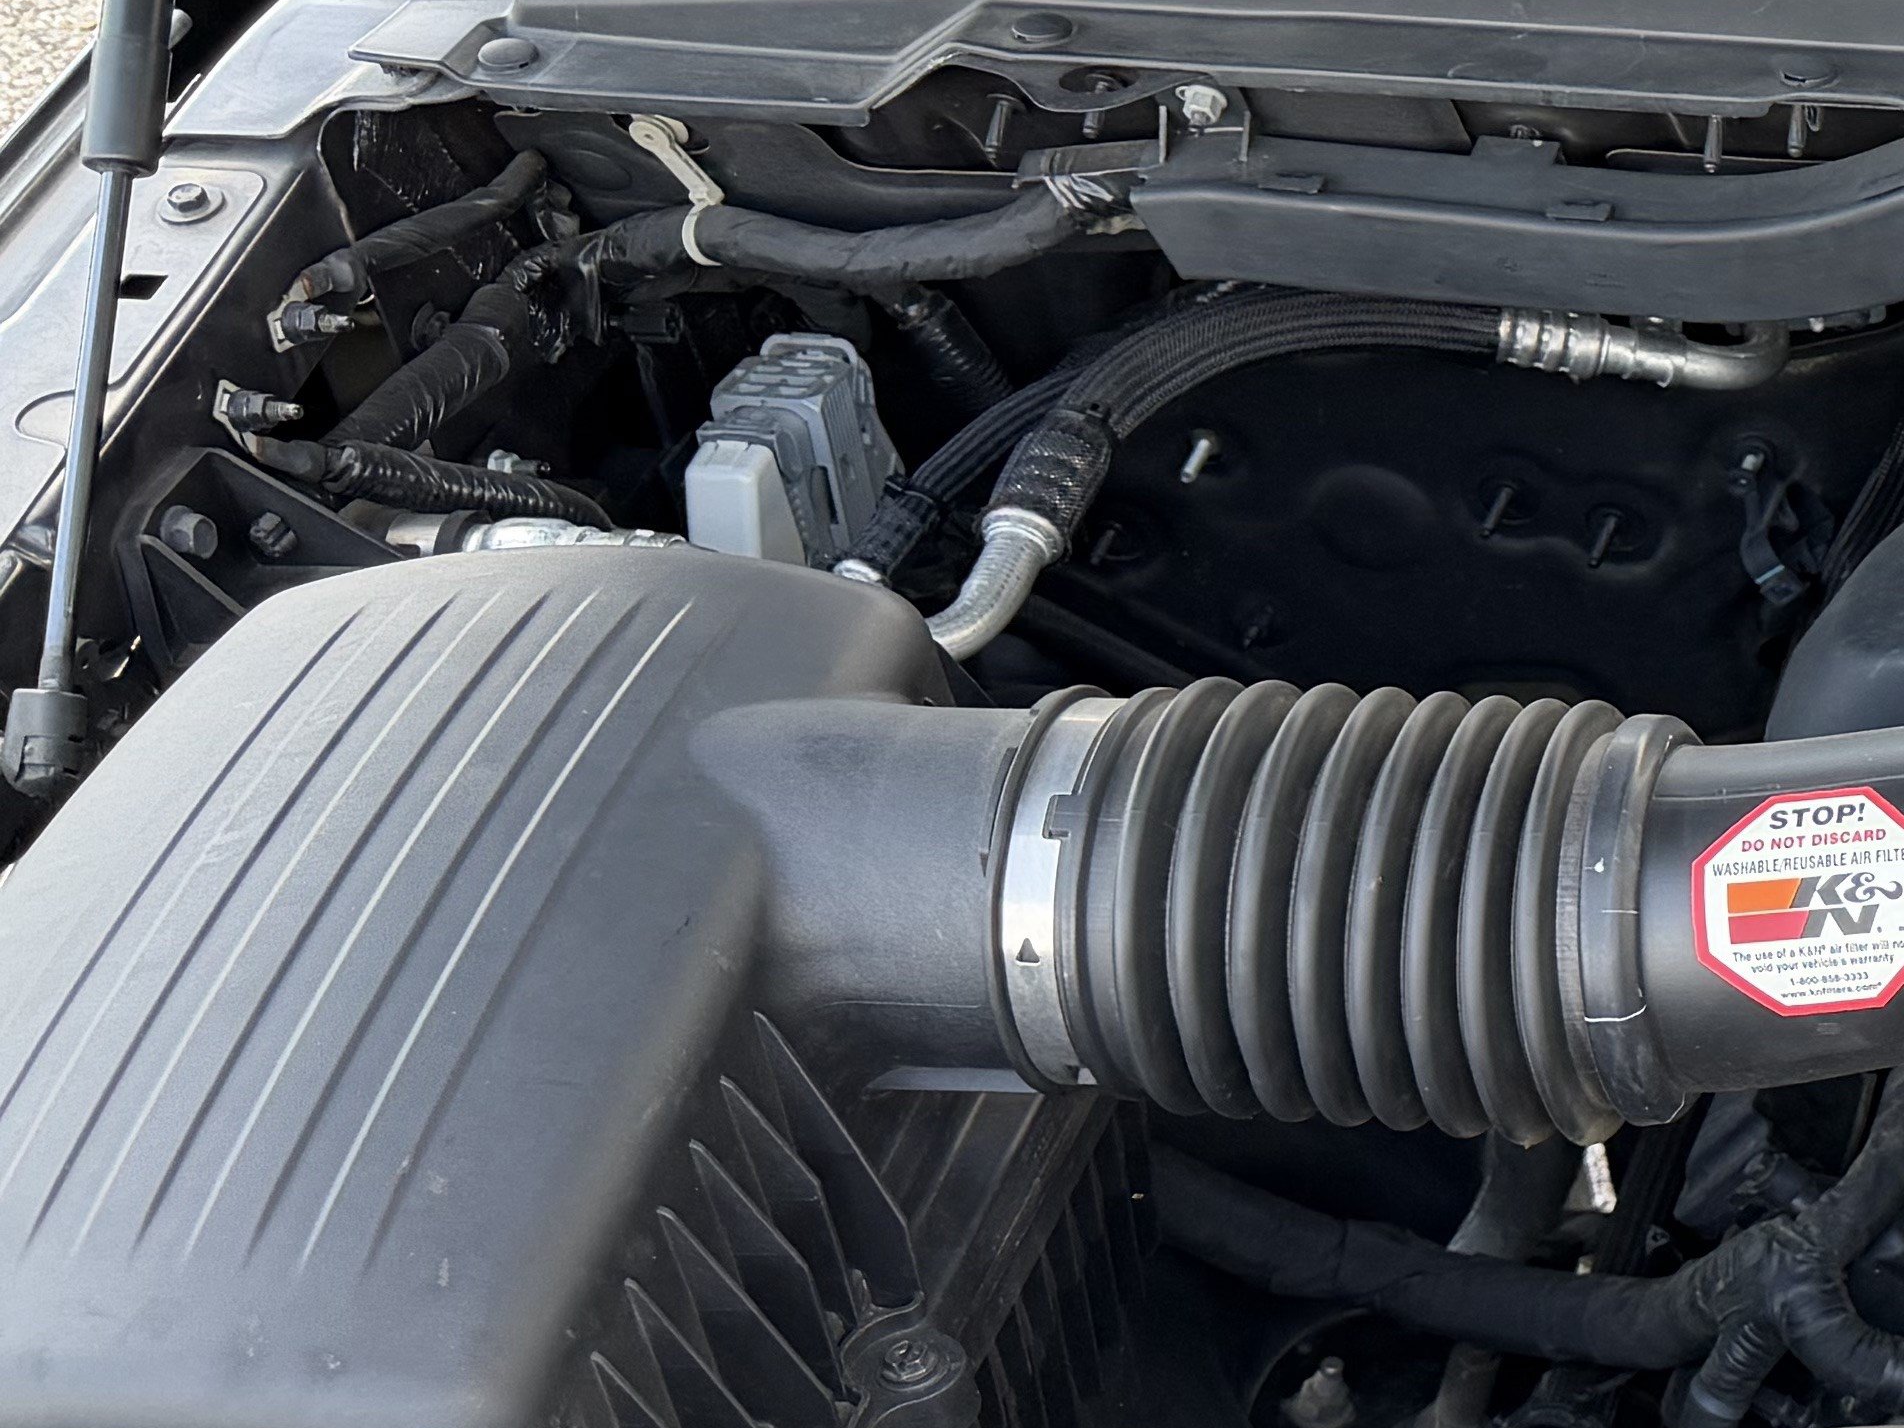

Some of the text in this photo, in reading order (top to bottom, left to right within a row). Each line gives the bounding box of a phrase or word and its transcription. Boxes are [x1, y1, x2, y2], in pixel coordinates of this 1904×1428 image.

[1769, 802, 1866, 830] STOP!
[1741, 828, 1887, 852] DO NOT DISCARD
[1712, 849, 1847, 877] WASHABLE/REUSABLE
[1851, 850, 1871, 865] AIR
[1732, 951, 1752, 963] The
[1755, 952, 1773, 961] use
[1777, 948, 1787, 959] of
[1790, 950, 1796, 958] a
[1830, 943, 1842, 954] air
[1845, 942, 1868, 953] filter
[1872, 939, 1889, 950] will
[1751, 961, 1773, 974] void
[1776, 962, 1799, 974] your
[1851, 953, 1895, 966] warranty
